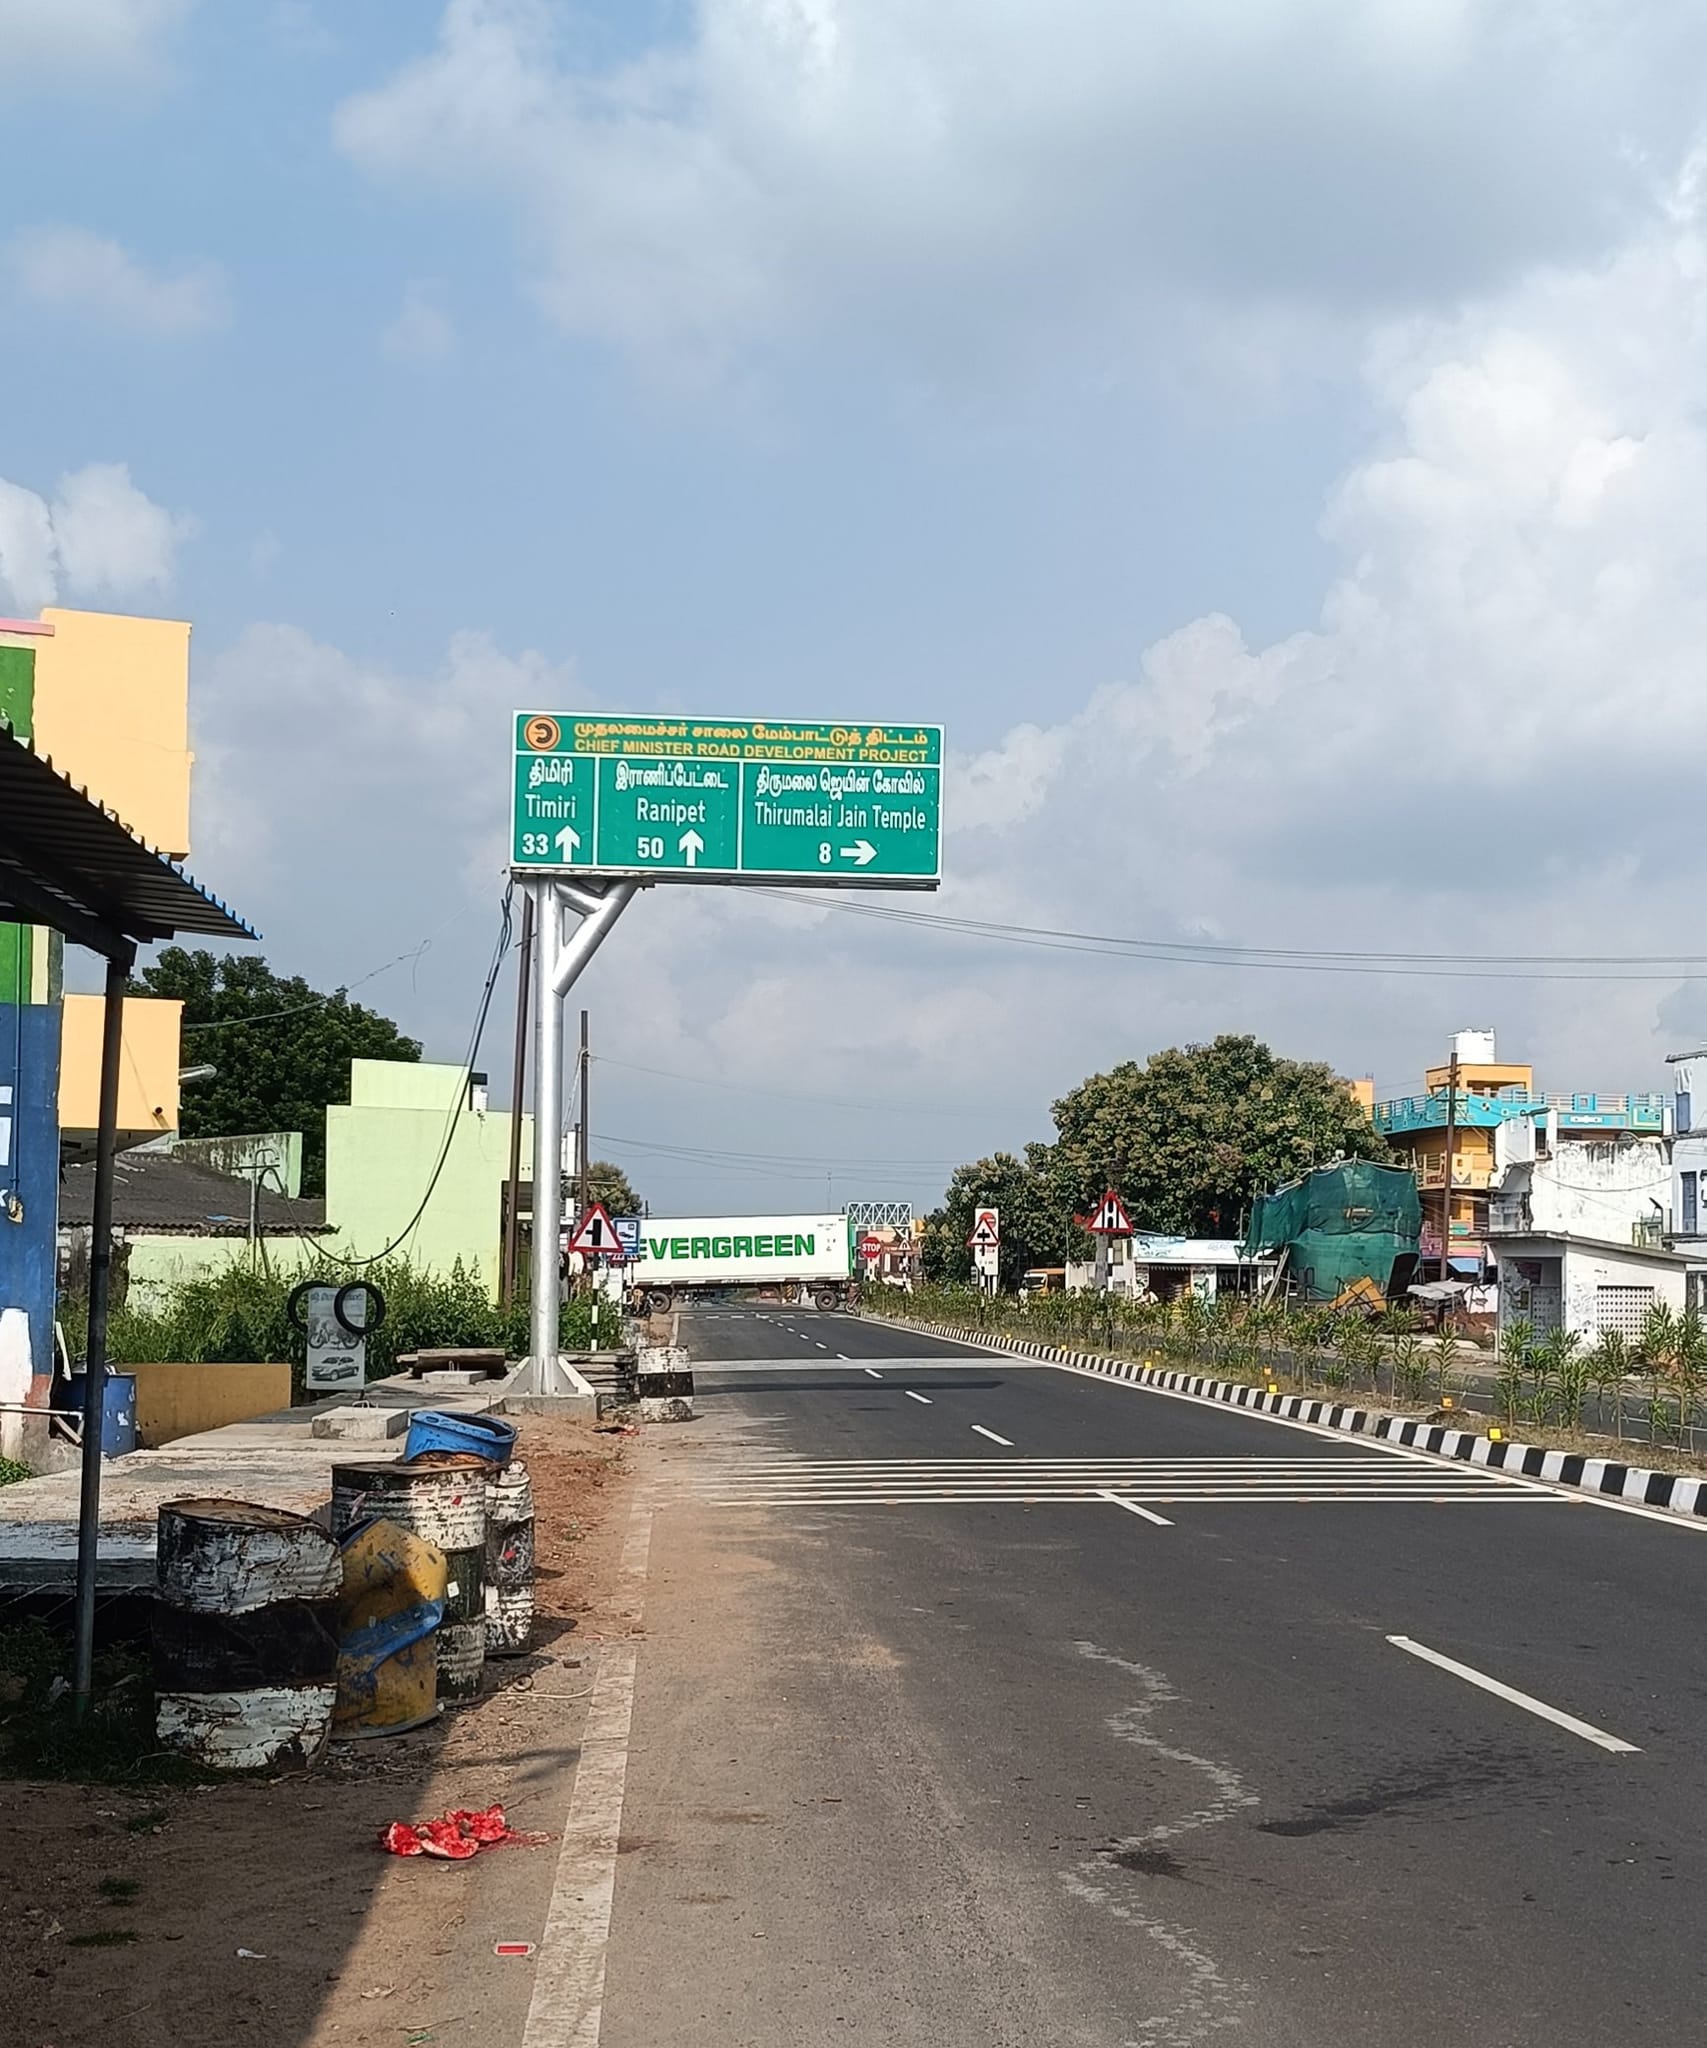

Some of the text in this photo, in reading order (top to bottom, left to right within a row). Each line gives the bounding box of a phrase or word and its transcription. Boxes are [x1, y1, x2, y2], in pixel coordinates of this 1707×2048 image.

[574, 721, 928, 746] முதலமைச்சர் சாலை மேம்பாட்டுத் திட்டம்
[574, 739, 928, 762] CHIEF MINISTER ROAD DEVELOPMENT PROJECT
[529, 758, 573, 789] திமிரி
[615, 760, 729, 791] இராணிப்பேட்டை
[755, 765, 925, 800] திருமலை ஜெயின் கோவில்
[525, 794, 576, 819] Timiri
[636, 797, 706, 827] Ranipet
[754, 801, 926, 833] Thirumalai Jain Temple
[522, 832, 549, 856] 33
[636, 836, 665, 859] 50
[818, 842, 832, 864] 8
[862, 1242, 881, 1252] STOP
